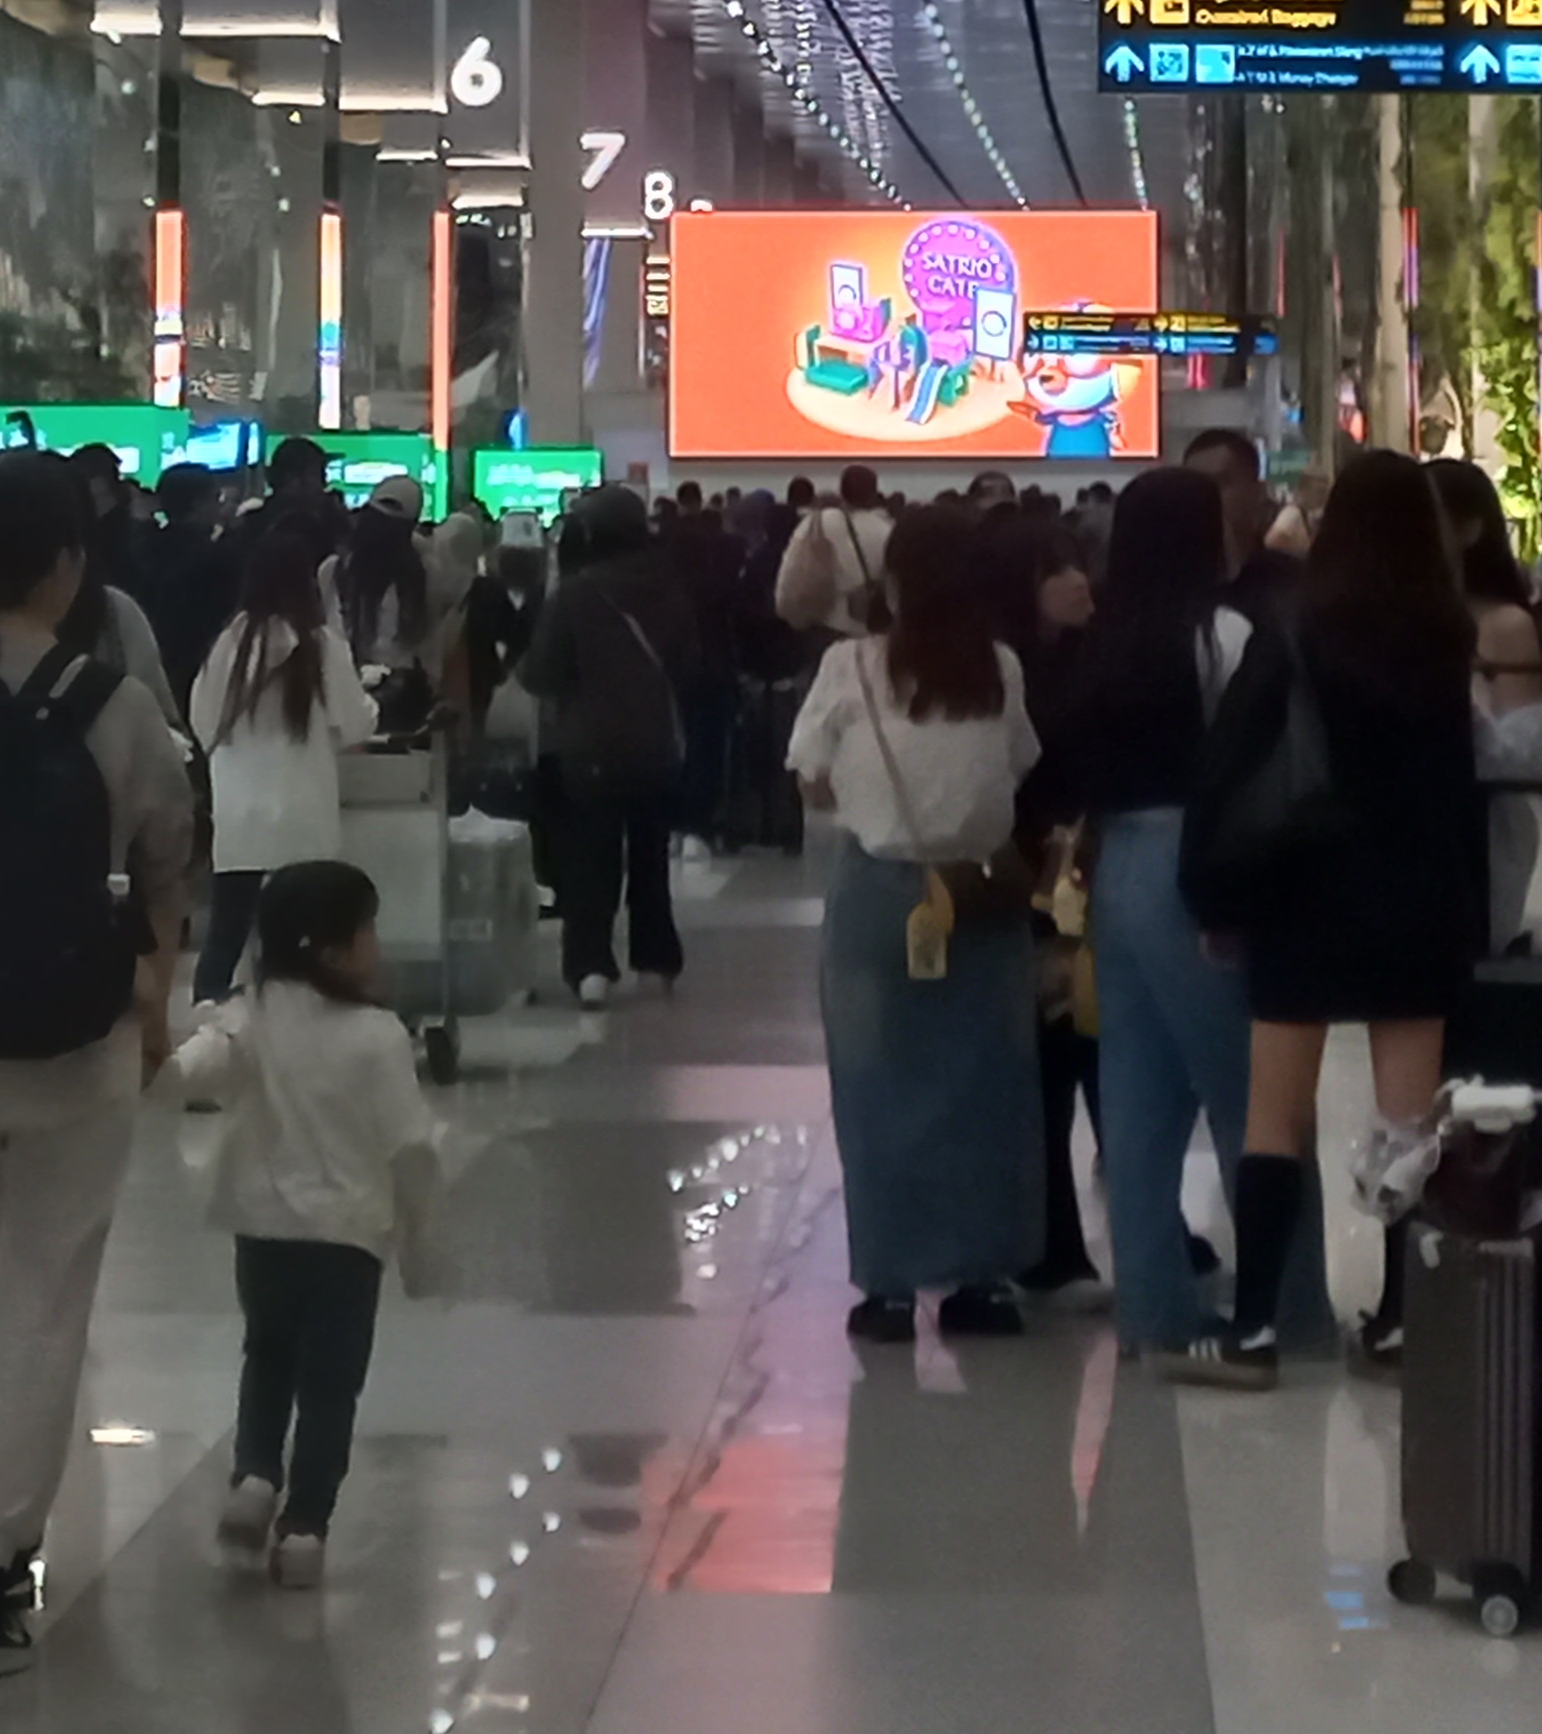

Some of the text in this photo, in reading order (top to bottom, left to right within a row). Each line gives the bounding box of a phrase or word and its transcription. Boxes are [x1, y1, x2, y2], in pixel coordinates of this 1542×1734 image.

[451, 36, 503, 107] 6
[580, 133, 625, 189] 7
[644, 171, 674, 220] 8
[922, 251, 993, 279] SATRIO
